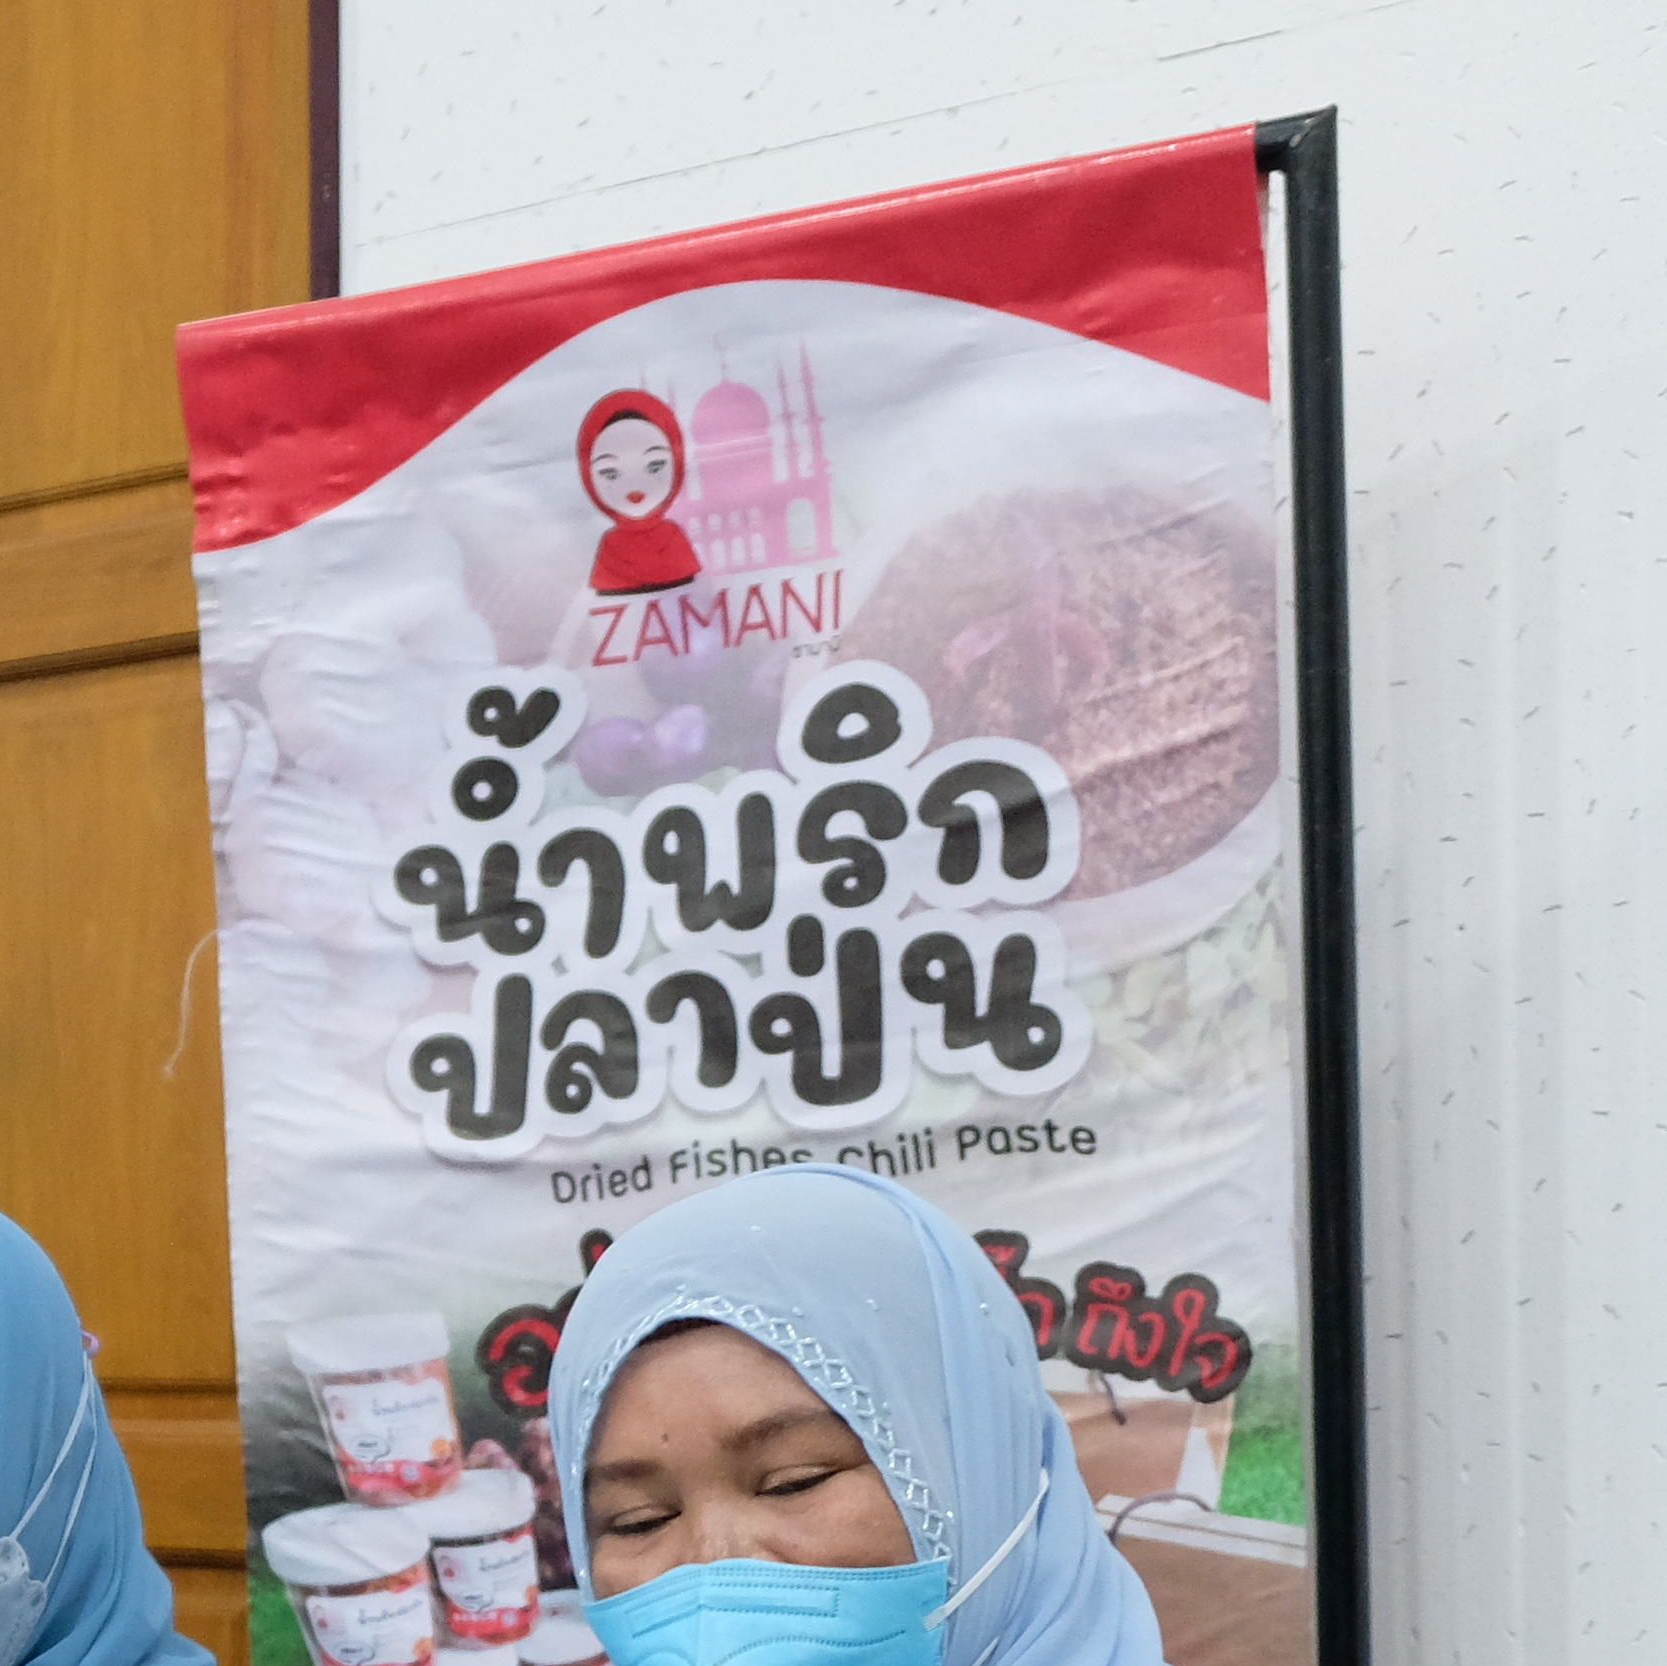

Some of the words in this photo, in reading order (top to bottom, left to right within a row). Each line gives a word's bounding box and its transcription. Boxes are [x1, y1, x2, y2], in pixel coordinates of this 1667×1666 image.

[589, 568, 844, 668] ZAMANI
[393, 682, 1051, 958] น้ำพริก
[409, 914, 1062, 1141] ปลาป่น
[550, 1155, 653, 1204] Dried
[956, 1118, 1098, 1162] Paste
